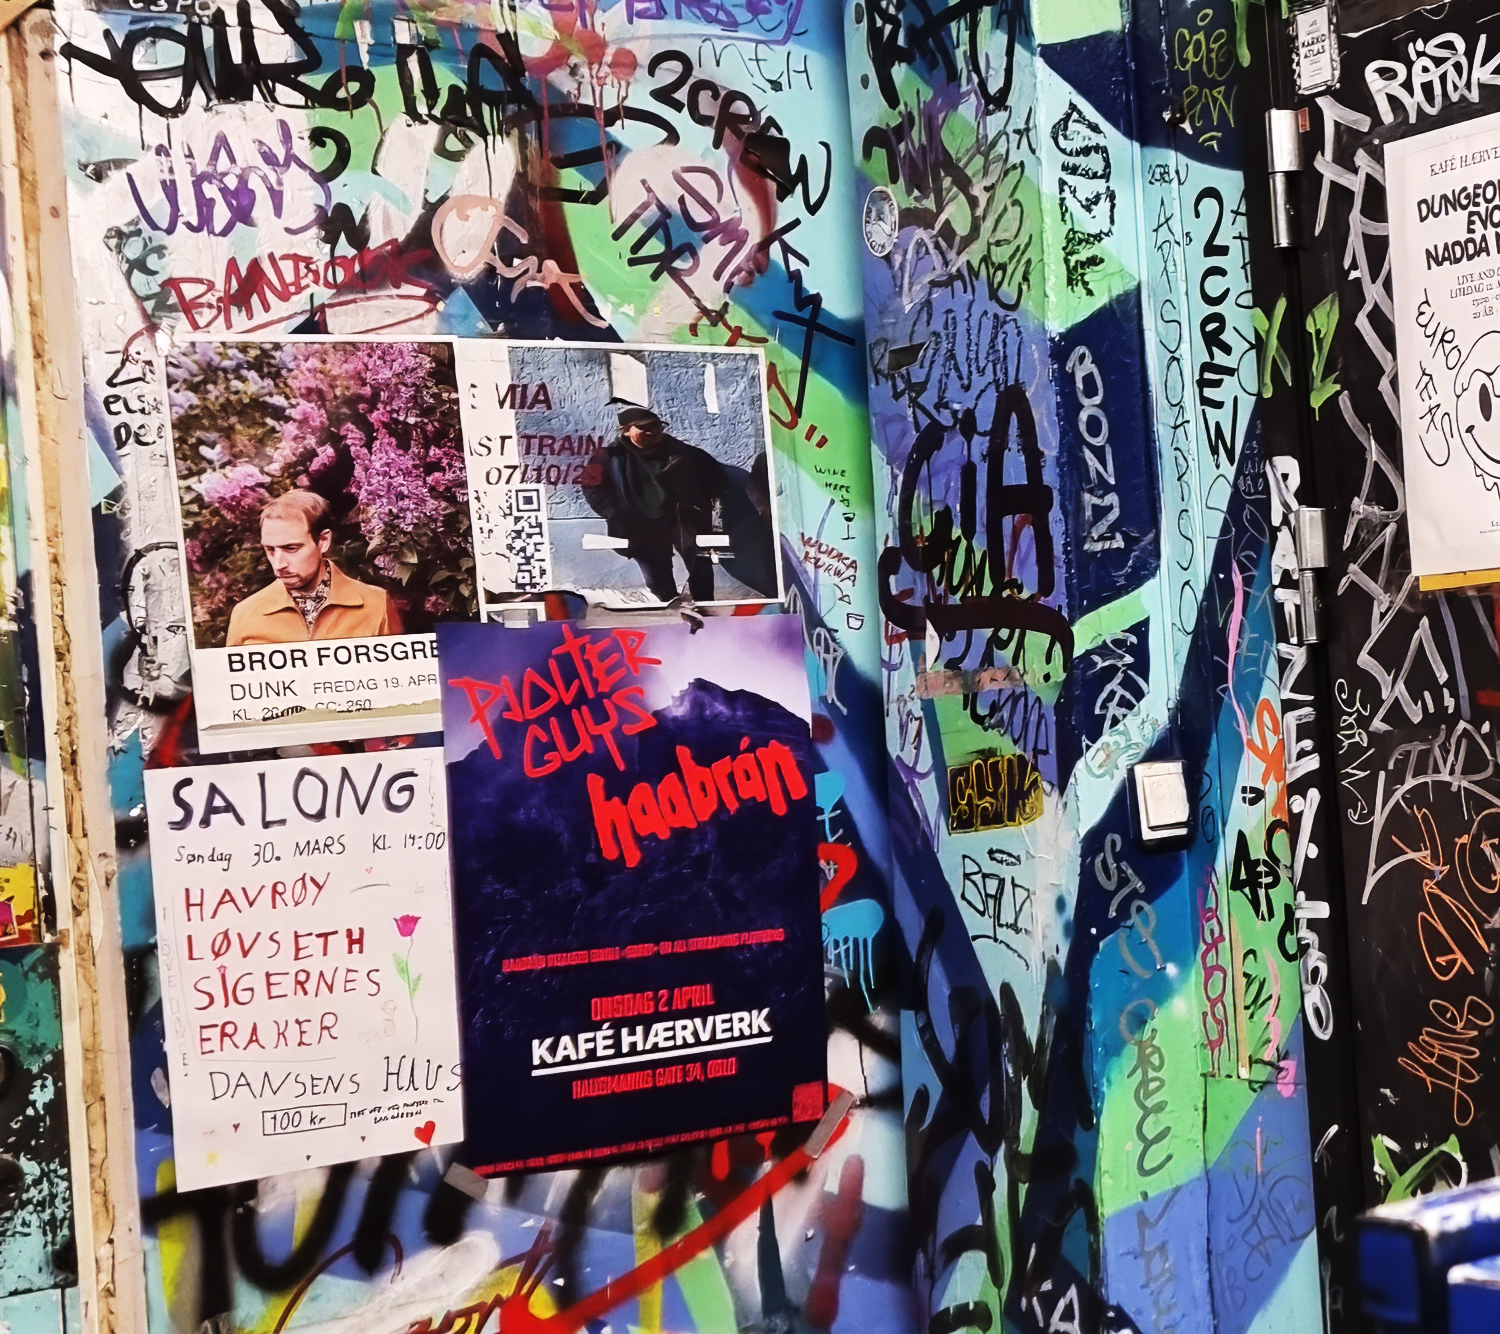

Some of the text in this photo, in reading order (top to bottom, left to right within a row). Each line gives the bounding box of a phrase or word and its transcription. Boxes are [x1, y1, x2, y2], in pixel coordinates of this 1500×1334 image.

[1425, 233, 1491, 271] NADDA
[228, 649, 308, 673] BROR
[230, 680, 297, 701] DUNK
[313, 678, 378, 694] FREDAG
[384, 675, 404, 688] 19.
[523, 685, 658, 779] GUYS
[175, 845, 232, 871] Søndag
[251, 842, 281, 867] 30.
[293, 834, 346, 858] MARS
[402, 831, 446, 851] 14:00
[183, 872, 330, 923] HAVRØY
[186, 927, 365, 962] LØVSETH
[657, 988, 669, 1012] 2
[671, 984, 715, 1009] APRIL
[200, 1011, 339, 1055] ERAKER
[532, 1007, 772, 1066] KAFÉ HÆRVERK
[209, 1071, 361, 1101] DANSENS
[270, 1112, 302, 1133] 100
